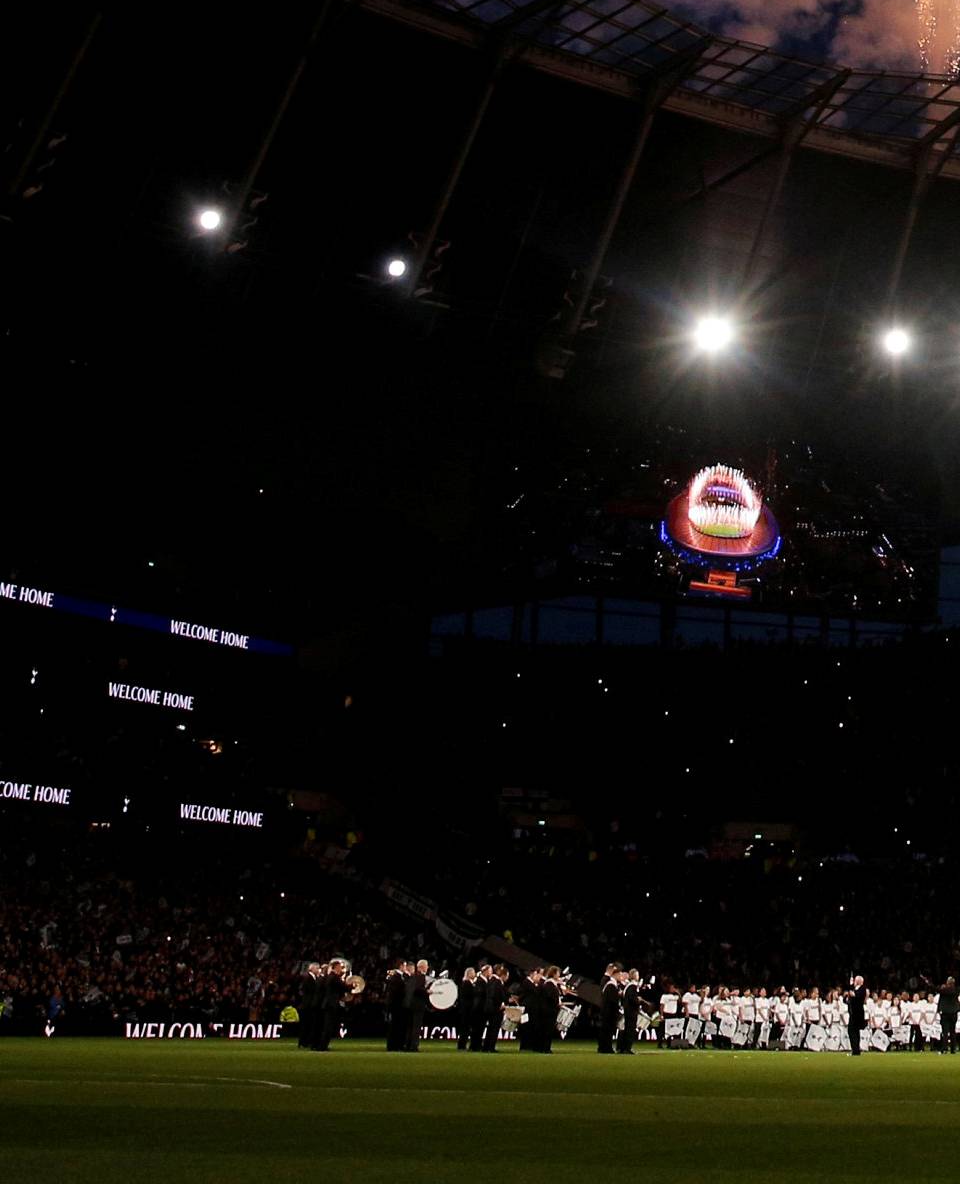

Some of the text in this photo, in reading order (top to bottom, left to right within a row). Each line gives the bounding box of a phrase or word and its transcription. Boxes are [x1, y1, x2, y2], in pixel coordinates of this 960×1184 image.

[0, 582, 54, 607] ME HOME
[170, 619, 249, 649] WELCOME HOME
[108, 682, 194, 710] WELCOME HOME
[34, 786, 71, 805] HOME
[180, 804, 263, 827] WELCOME HOME
[126, 1023, 223, 1038] WECOM
